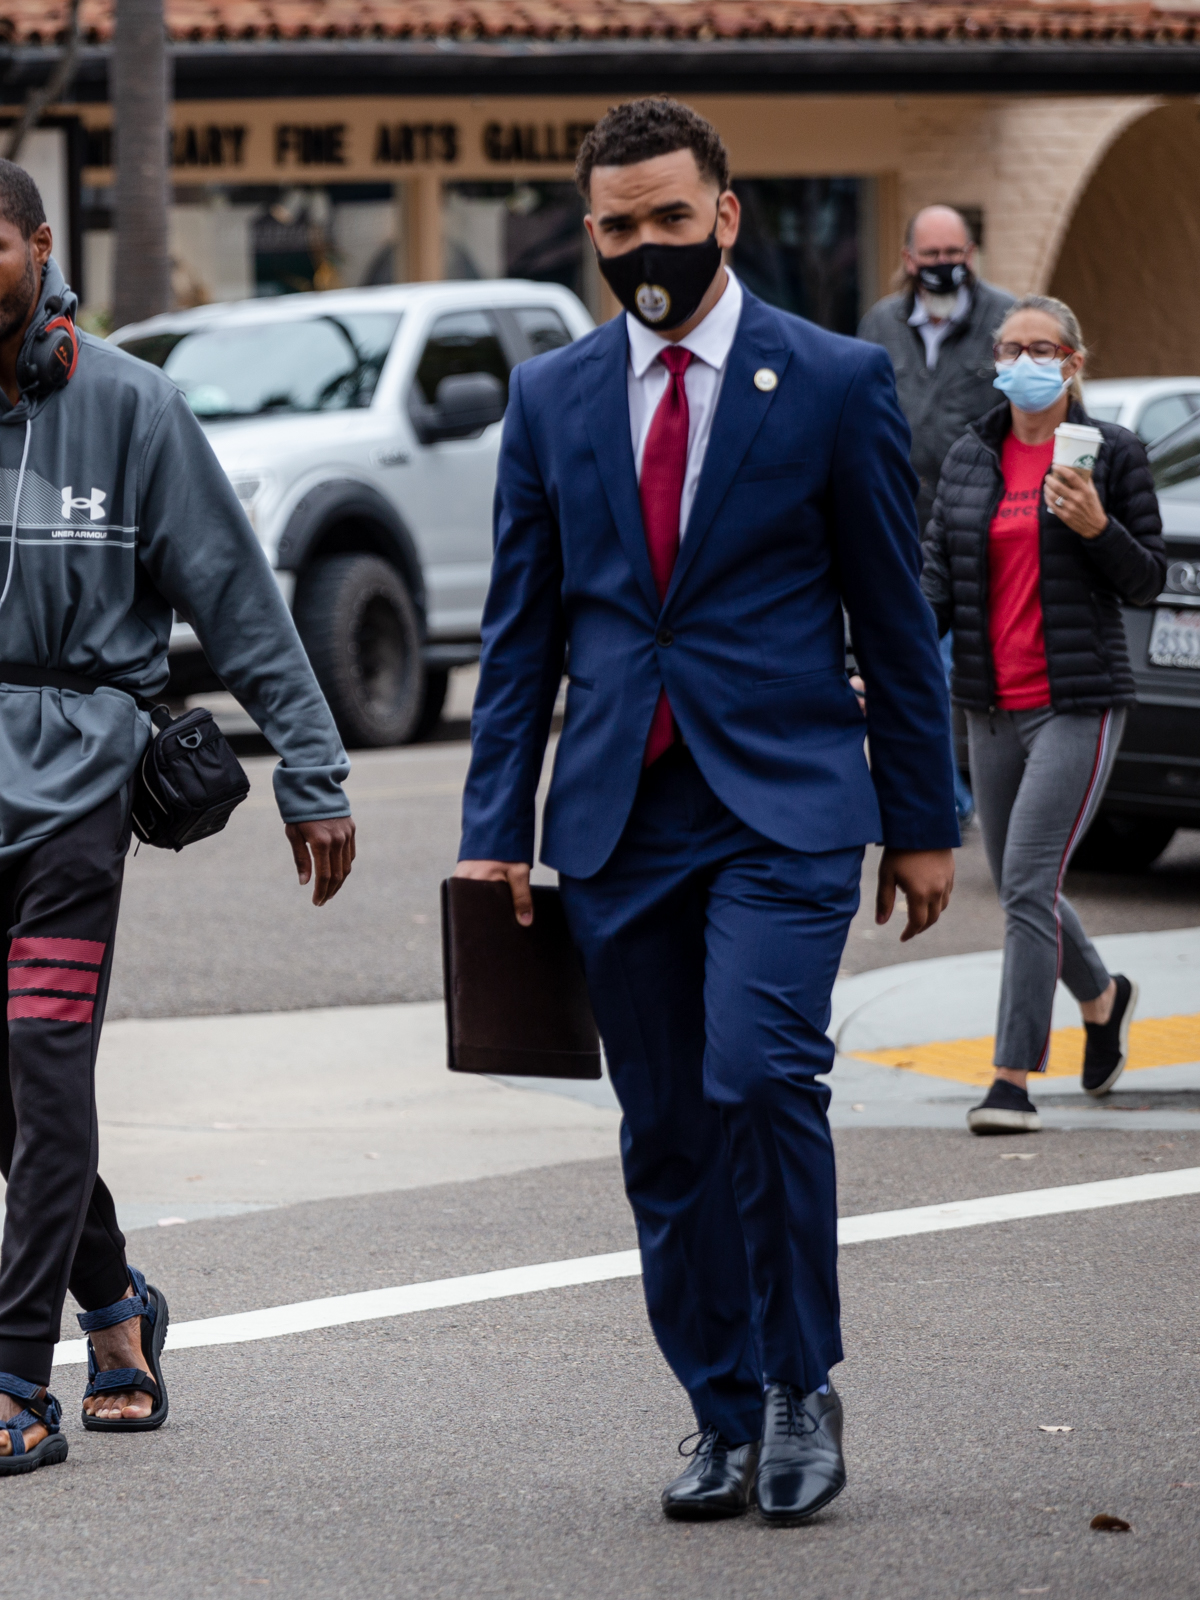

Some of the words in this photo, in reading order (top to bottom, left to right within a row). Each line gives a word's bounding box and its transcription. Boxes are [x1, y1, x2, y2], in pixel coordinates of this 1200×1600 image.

[273, 123, 347, 165] FINE
[372, 122, 457, 163] ARTS
[51, 530, 75, 538] UNER
